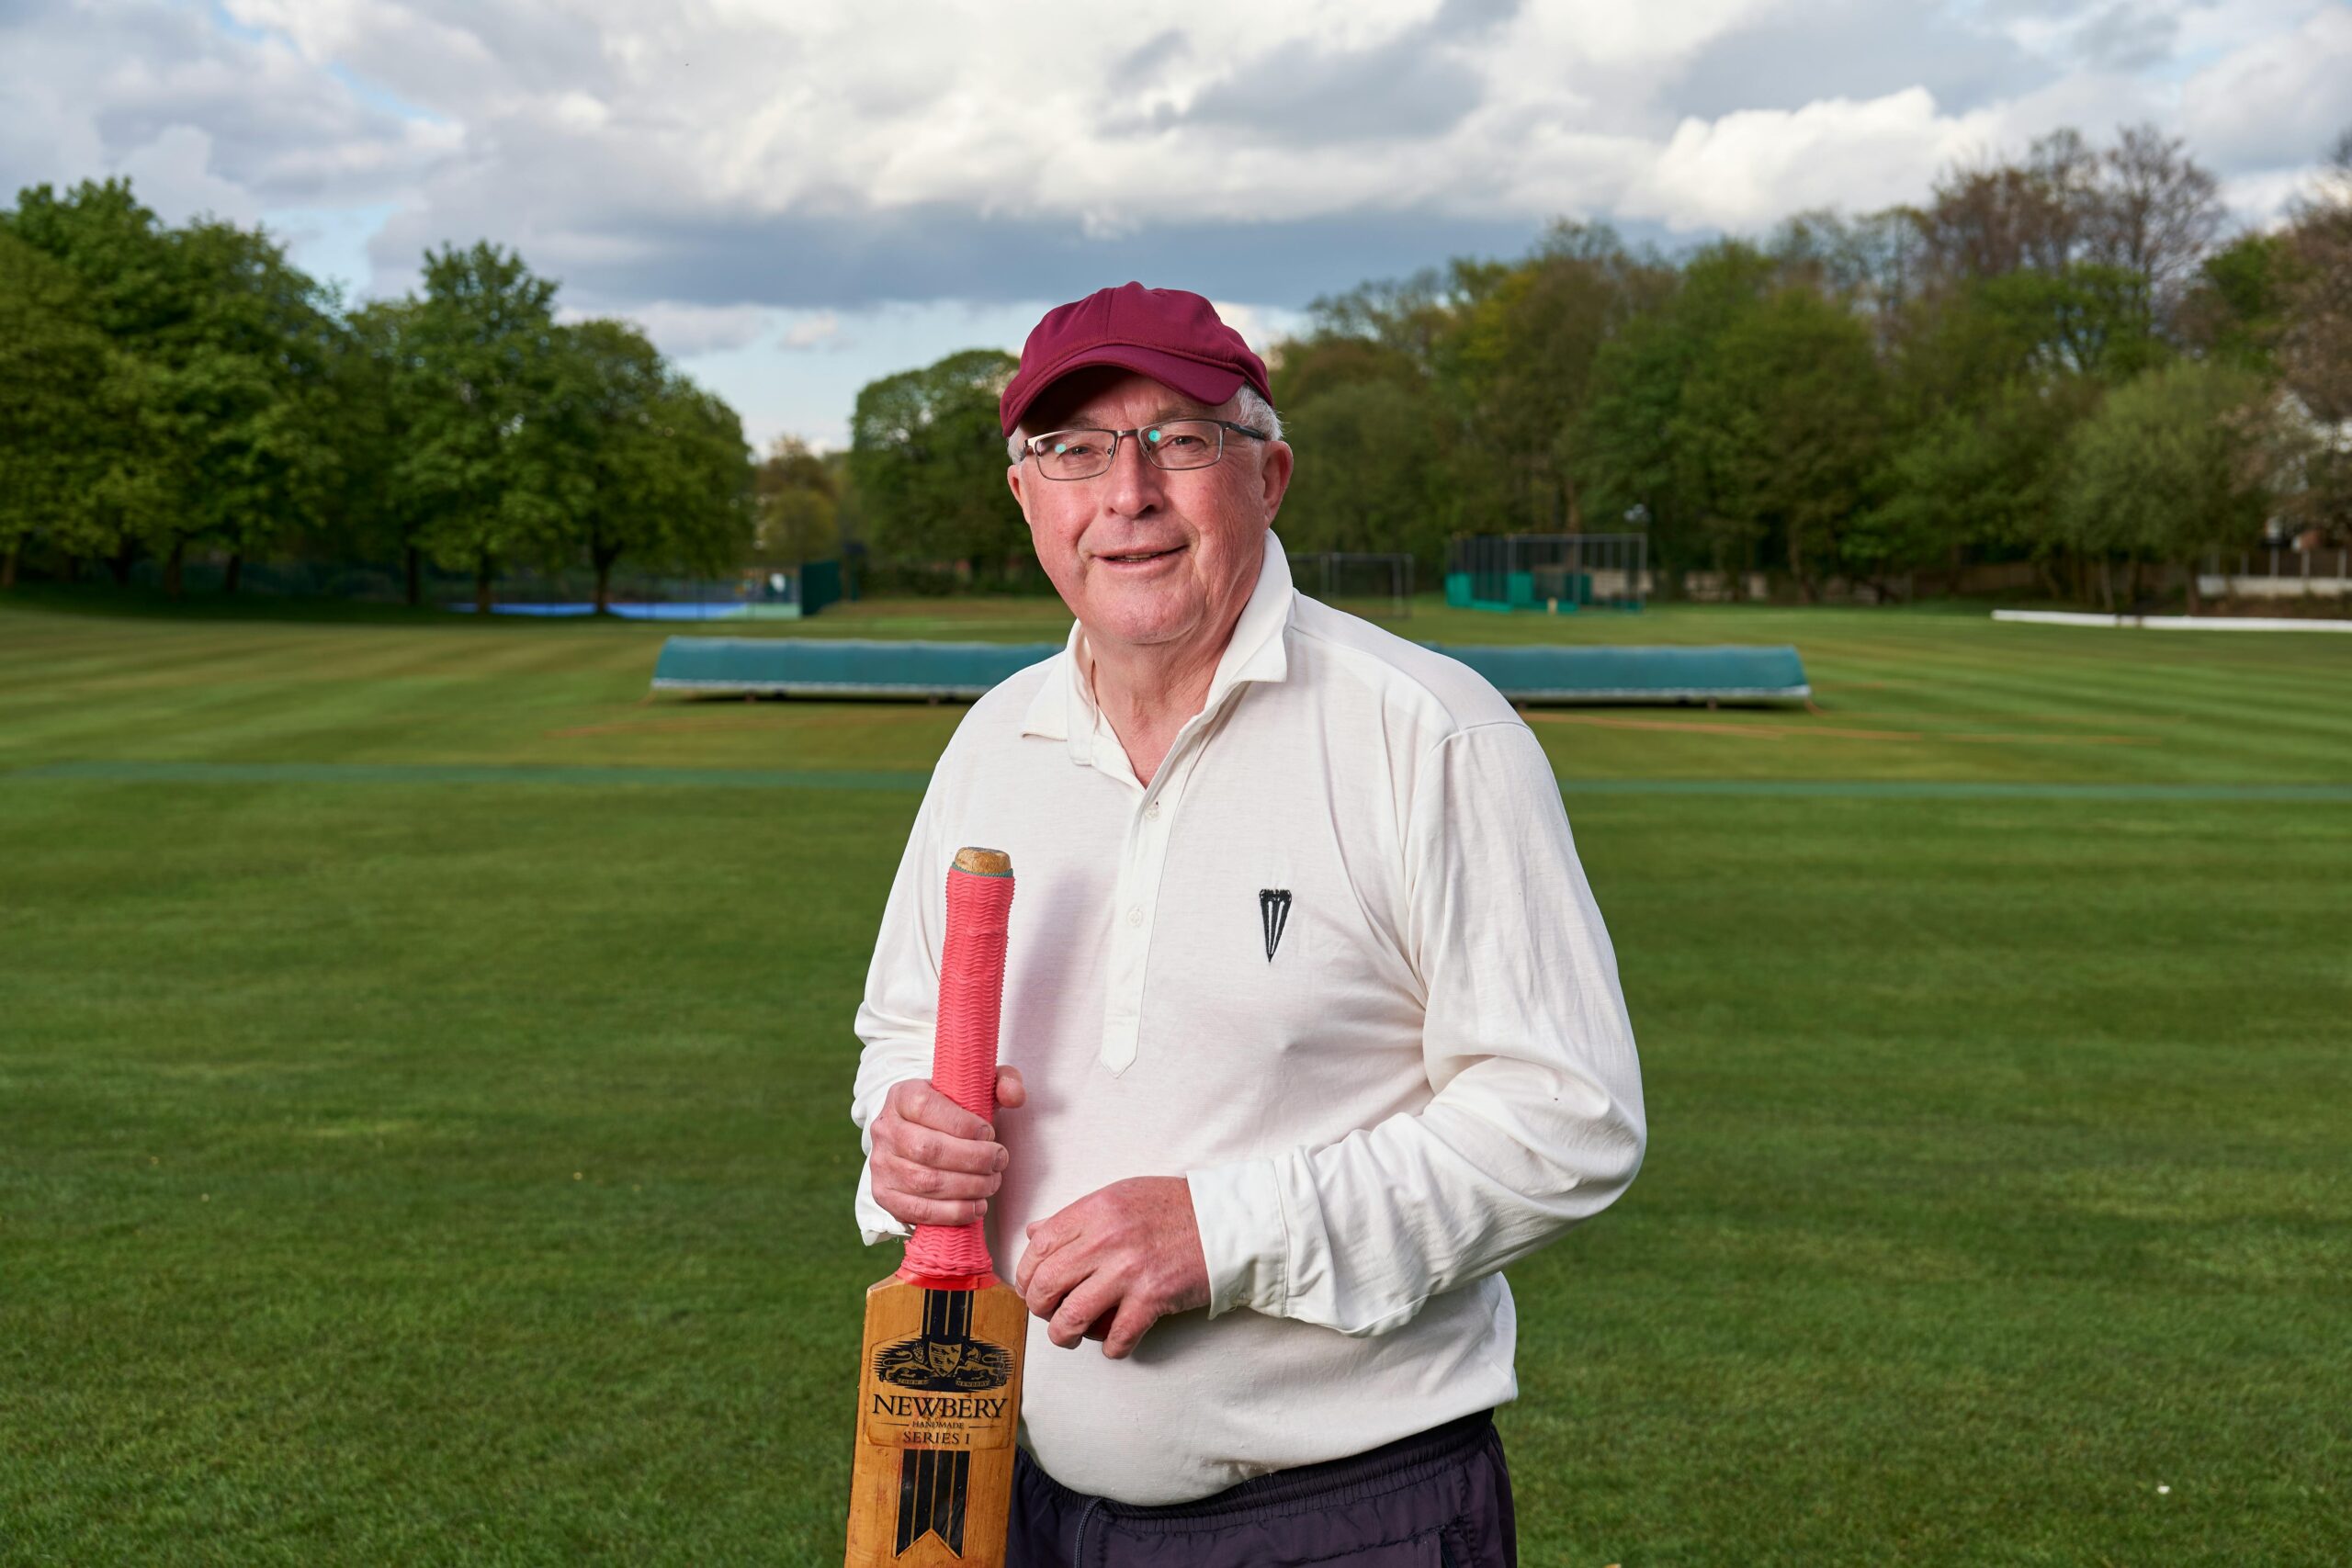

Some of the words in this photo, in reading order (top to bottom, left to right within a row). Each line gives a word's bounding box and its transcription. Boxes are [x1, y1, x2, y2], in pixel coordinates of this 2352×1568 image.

[872, 1393, 1007, 1418] NEWBERY
[911, 1420, 965, 1429] HANDMADE
[903, 1430, 959, 1445] SERIES
